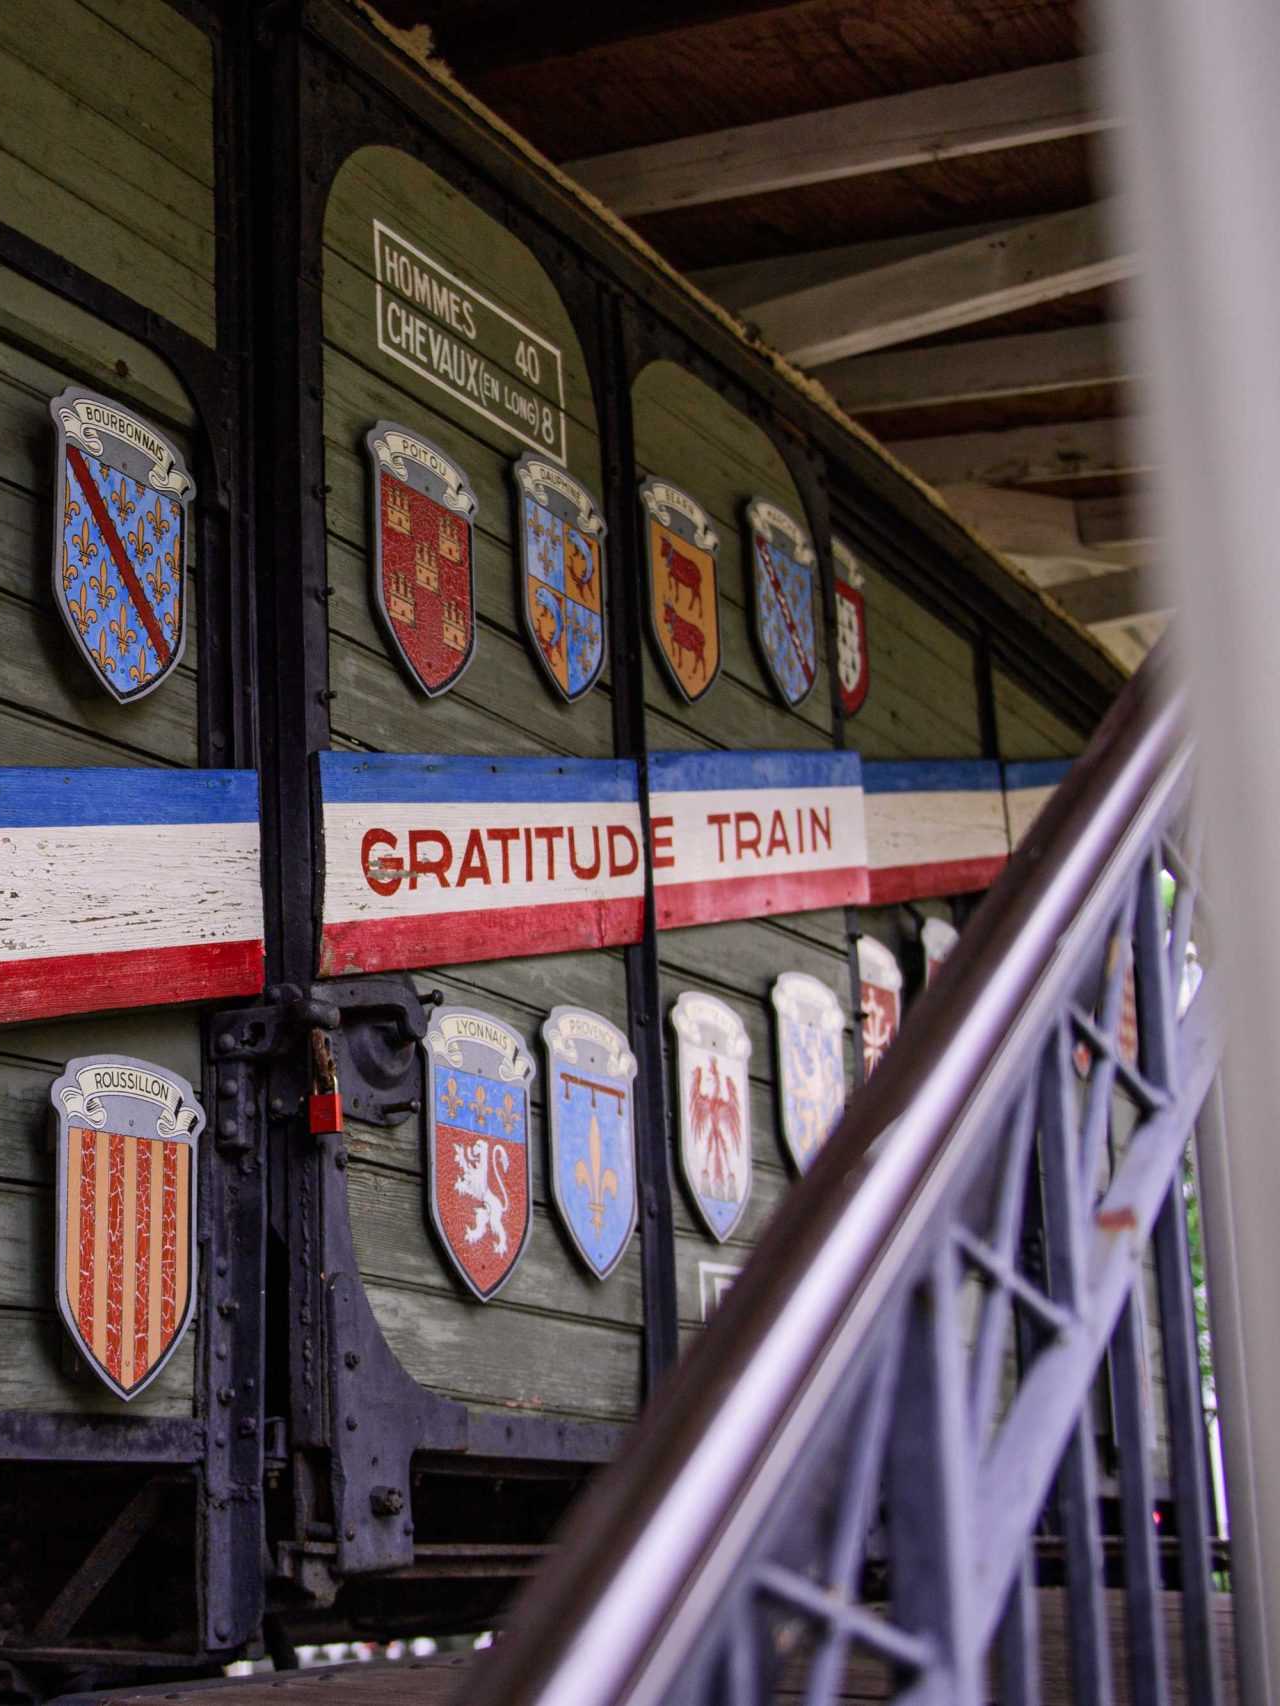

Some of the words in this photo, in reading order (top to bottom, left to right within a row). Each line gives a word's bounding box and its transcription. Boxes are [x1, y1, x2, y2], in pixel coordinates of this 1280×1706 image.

[384, 246, 477, 340] HOMMES
[515, 340, 540, 385] 40
[85, 406, 166, 461] BOURBONNAIS
[504, 385, 539, 436] LONG)
[541, 406, 555, 445] 8
[402, 439, 447, 476] POITOU
[360, 814, 674, 897] GRATITUDE
[707, 806, 833, 863] TRAIN
[455, 1019, 508, 1050] LYONNAIS
[94, 1071, 169, 1101] ROUSSILLON
